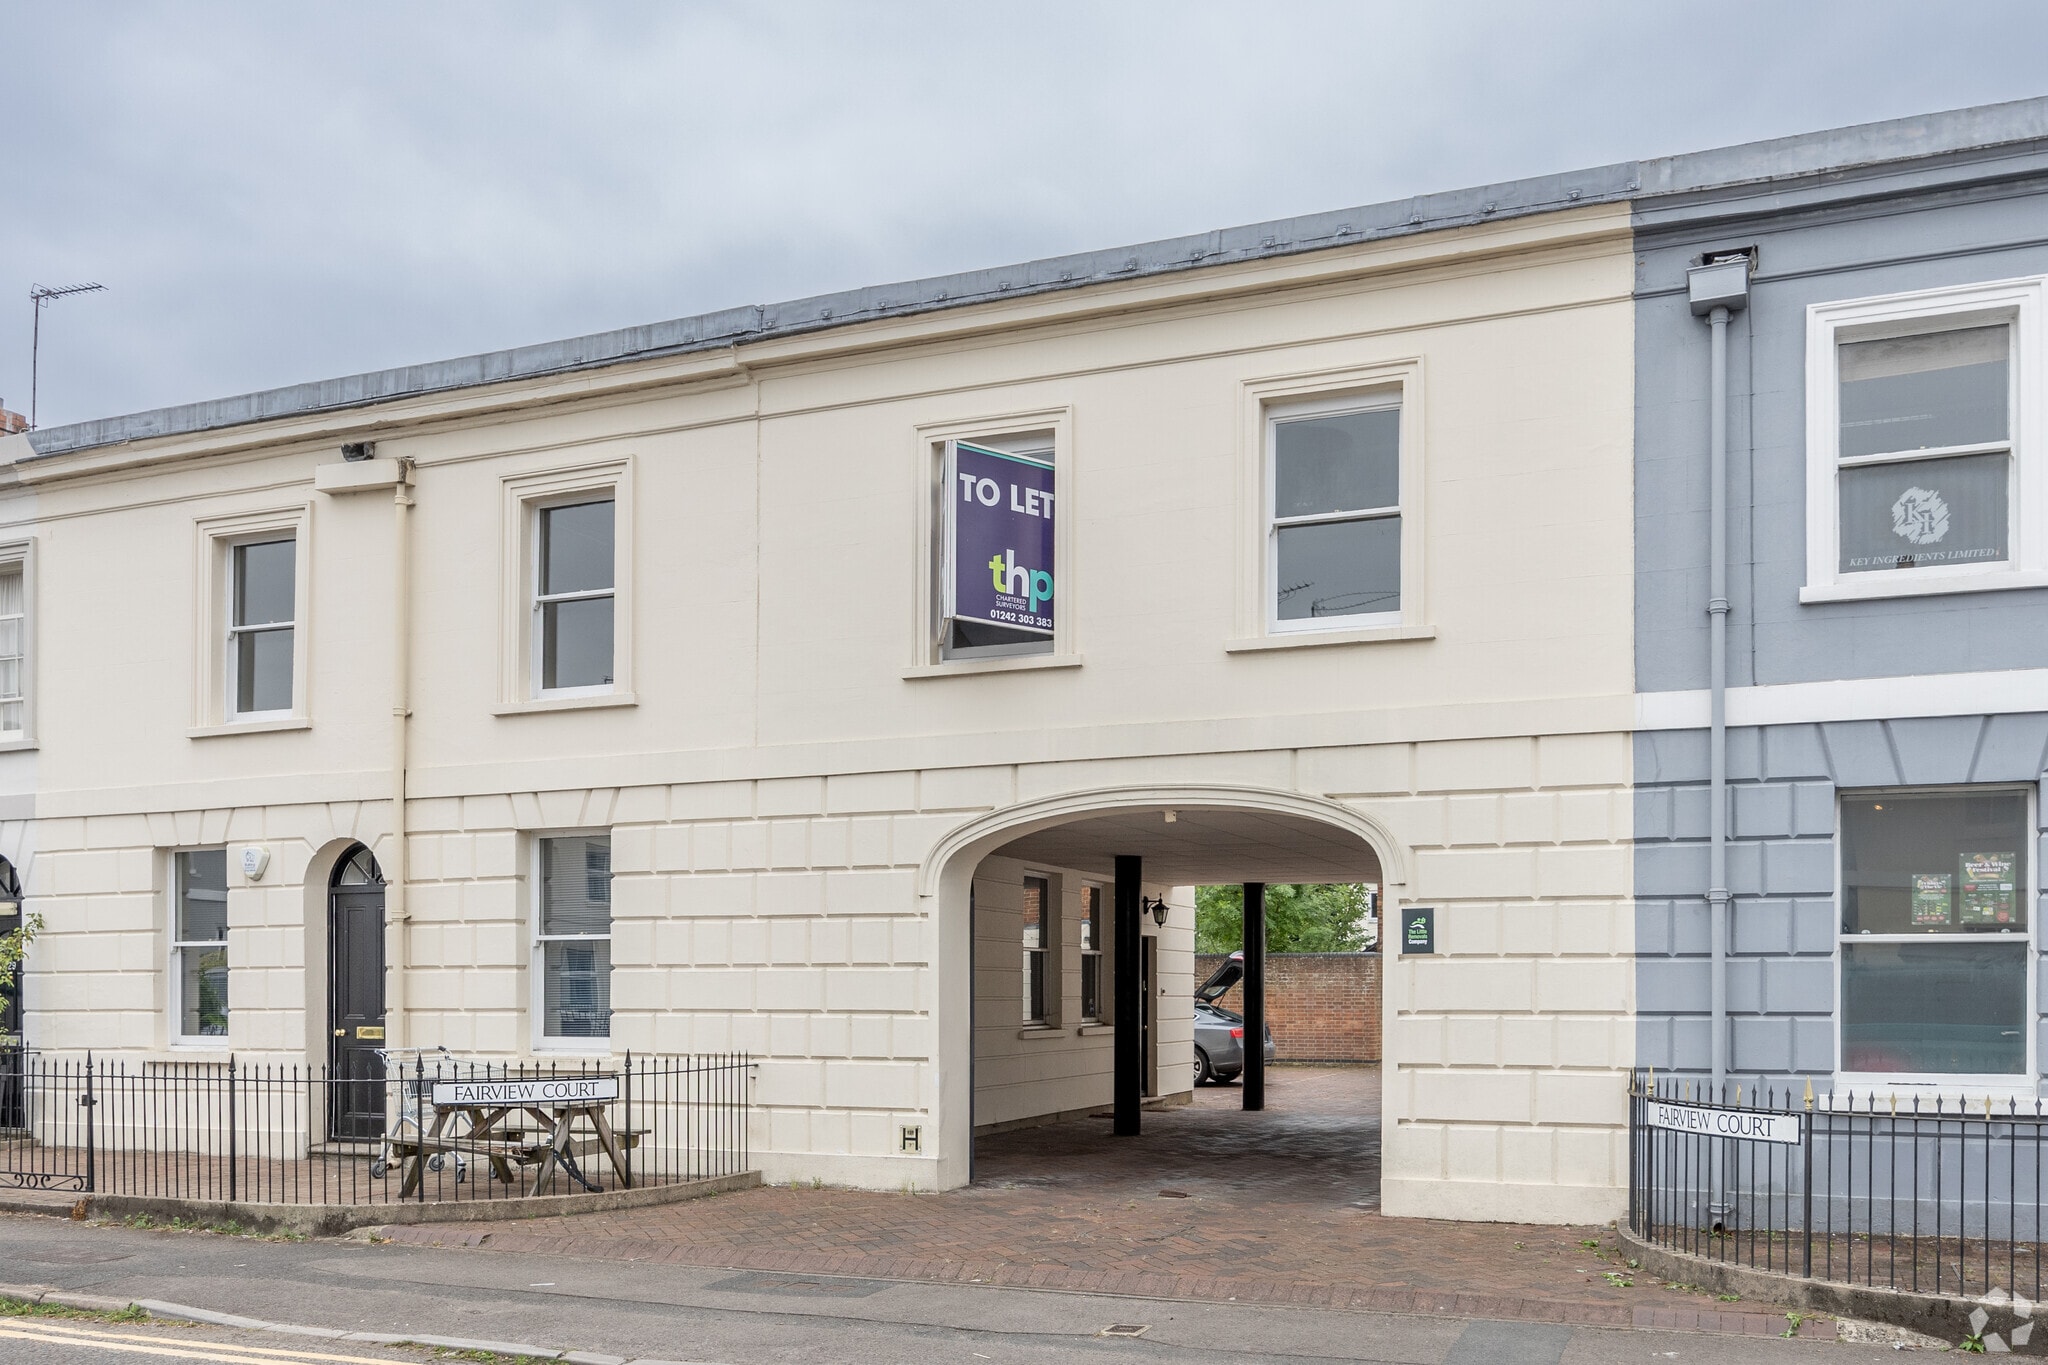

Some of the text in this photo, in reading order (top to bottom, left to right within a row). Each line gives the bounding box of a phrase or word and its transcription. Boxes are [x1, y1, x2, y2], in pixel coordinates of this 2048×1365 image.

[959, 473, 1055, 519] TO LET
[1849, 547, 1995, 567] KEY INGREDIENTS LIMITED
[988, 549, 1055, 613] thp
[995, 594, 1027, 605] CHARTERED
[995, 600, 1027, 611] SURVEYORS
[990, 609, 1053, 628] 01242 303 383
[454, 1081, 600, 1101] FAIRVIEW COURT
[1658, 1106, 1776, 1137] FAIRVIEW COURT
[903, 1128, 918, 1150] H
